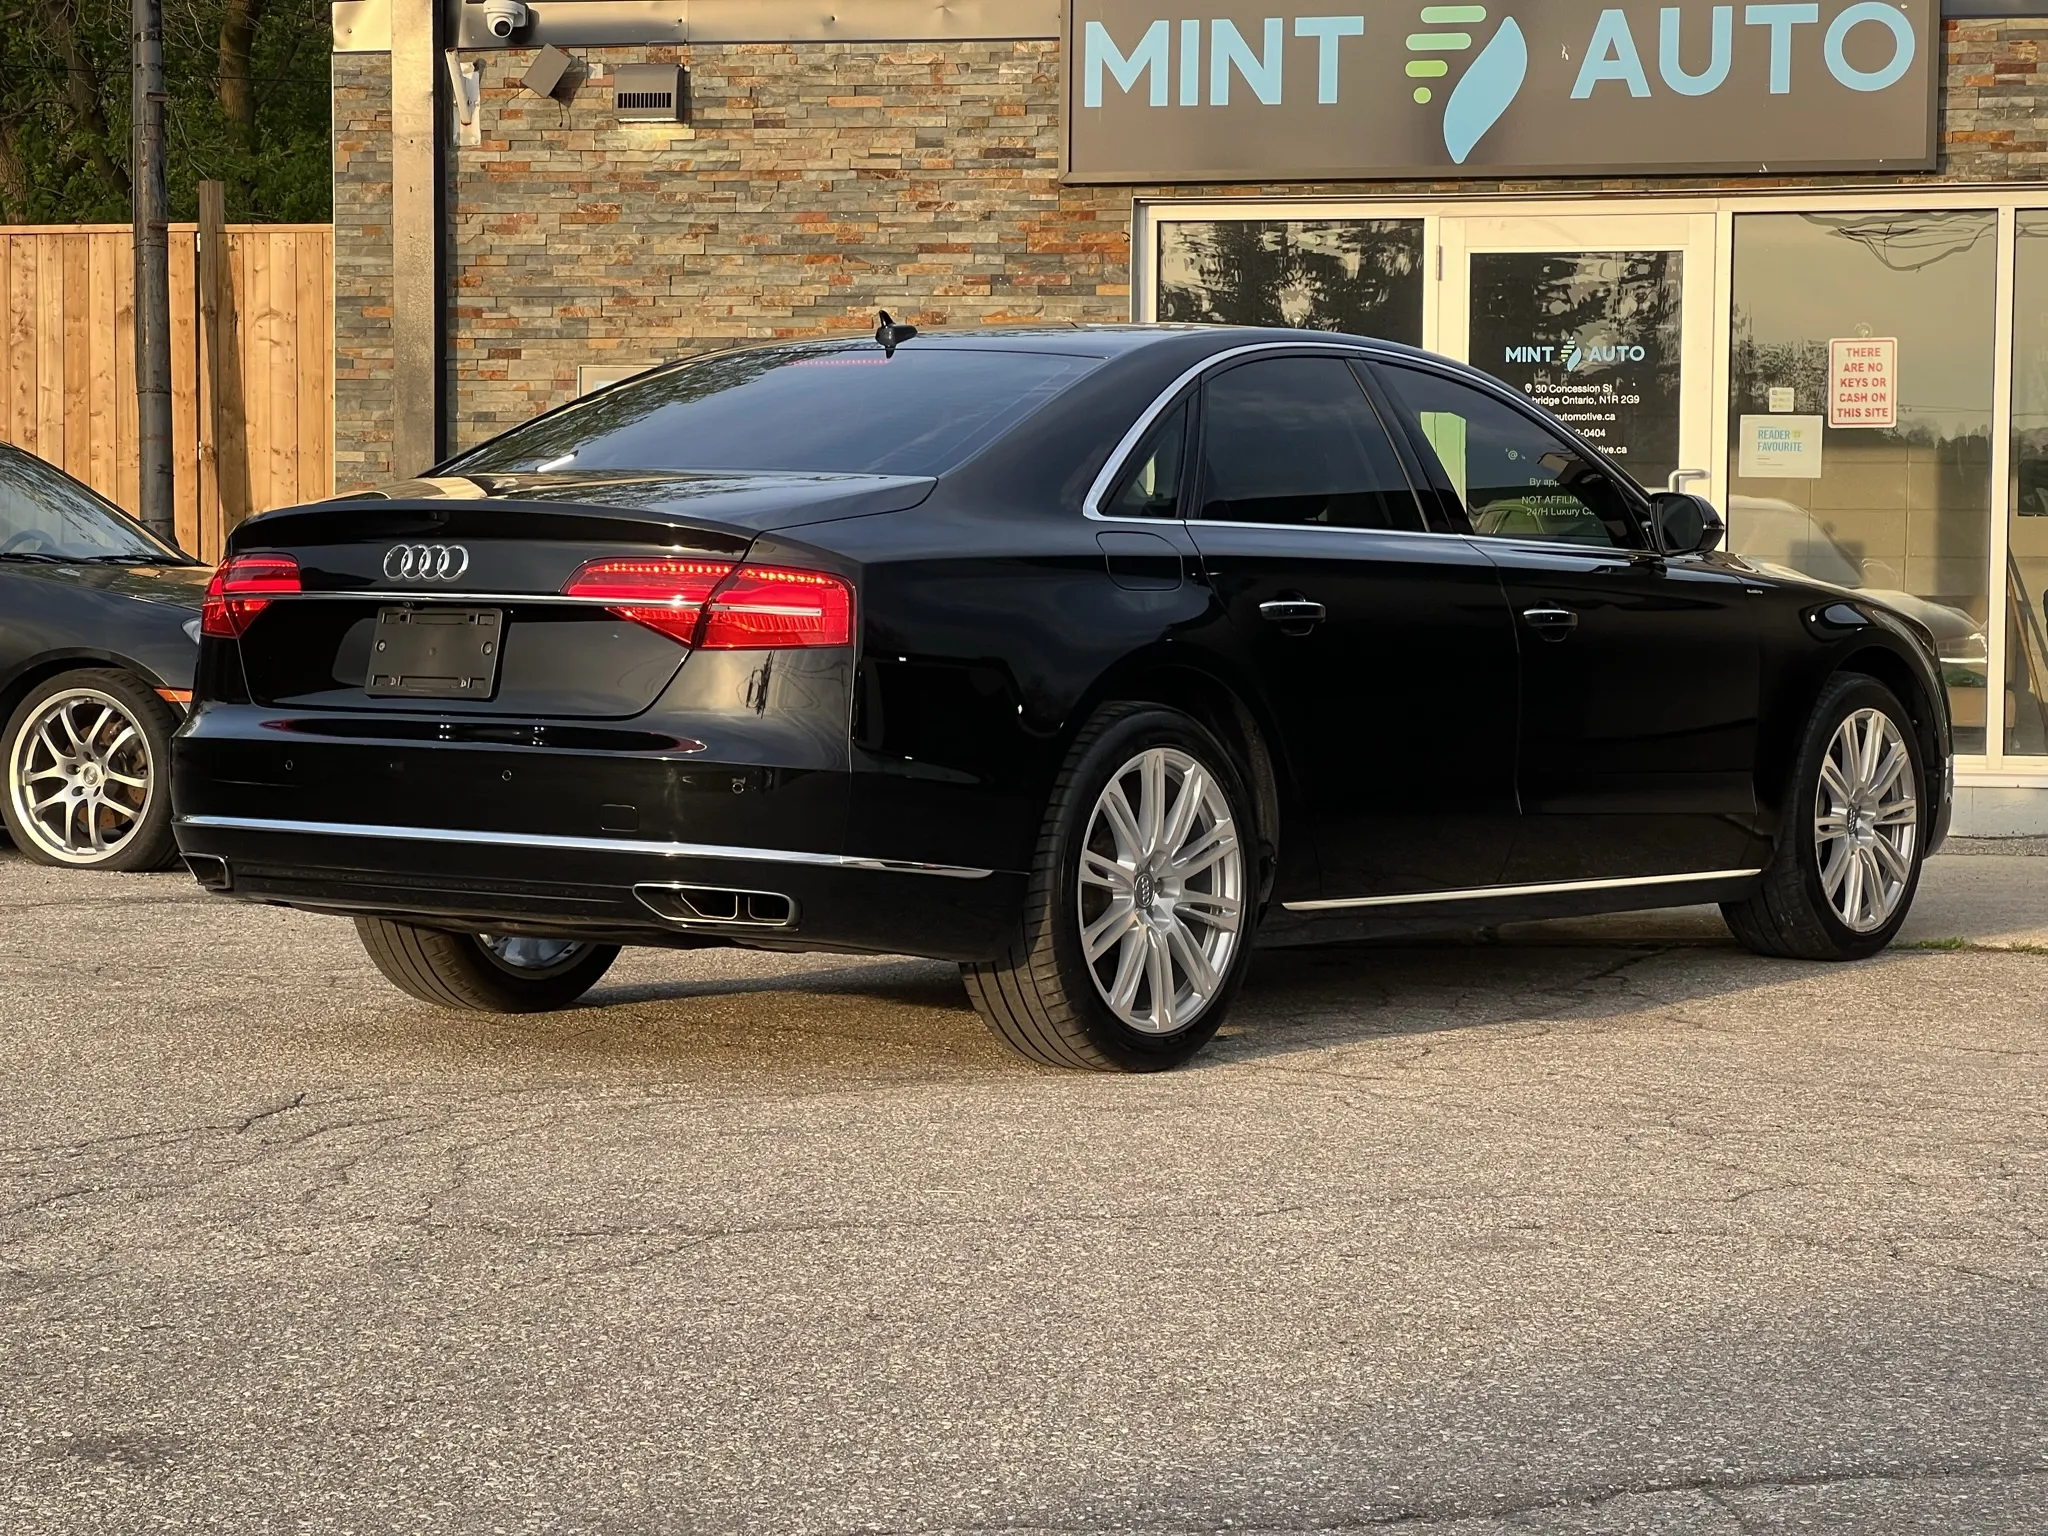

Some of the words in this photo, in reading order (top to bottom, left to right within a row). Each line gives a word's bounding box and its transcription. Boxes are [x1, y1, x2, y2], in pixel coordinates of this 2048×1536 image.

[1084, 16, 1364, 107] MINT
[1570, 2, 1915, 99] AUTO
[1505, 346, 1555, 363] MINT
[1588, 345, 1646, 362] AUTO
[1846, 347, 1881, 357] THERE
[1843, 362, 1865, 373] ARE
[1867, 362, 1883, 373] NO
[1840, 377, 1868, 388] KEYS
[1871, 377, 1887, 388] OR
[1535, 384, 1547, 394] 30
[1549, 384, 1601, 394] Concession
[1602, 383, 1613, 393] St
[1561, 395, 1597, 406] Ontario,
[1599, 394, 1619, 405] N1R
[1620, 394, 1640, 405] 2G9
[1839, 392, 1868, 403] CASH
[1871, 392, 1887, 402] ON
[1837, 407, 1862, 418] THIS
[1864, 407, 1888, 418] SITE
[1757, 429, 1790, 440] READER
[1757, 441, 1803, 452] FAVOURITE
[1529, 477, 1541, 487] By
[1521, 495, 1542, 505] NOT
[1550, 507, 1580, 517] Luxury
